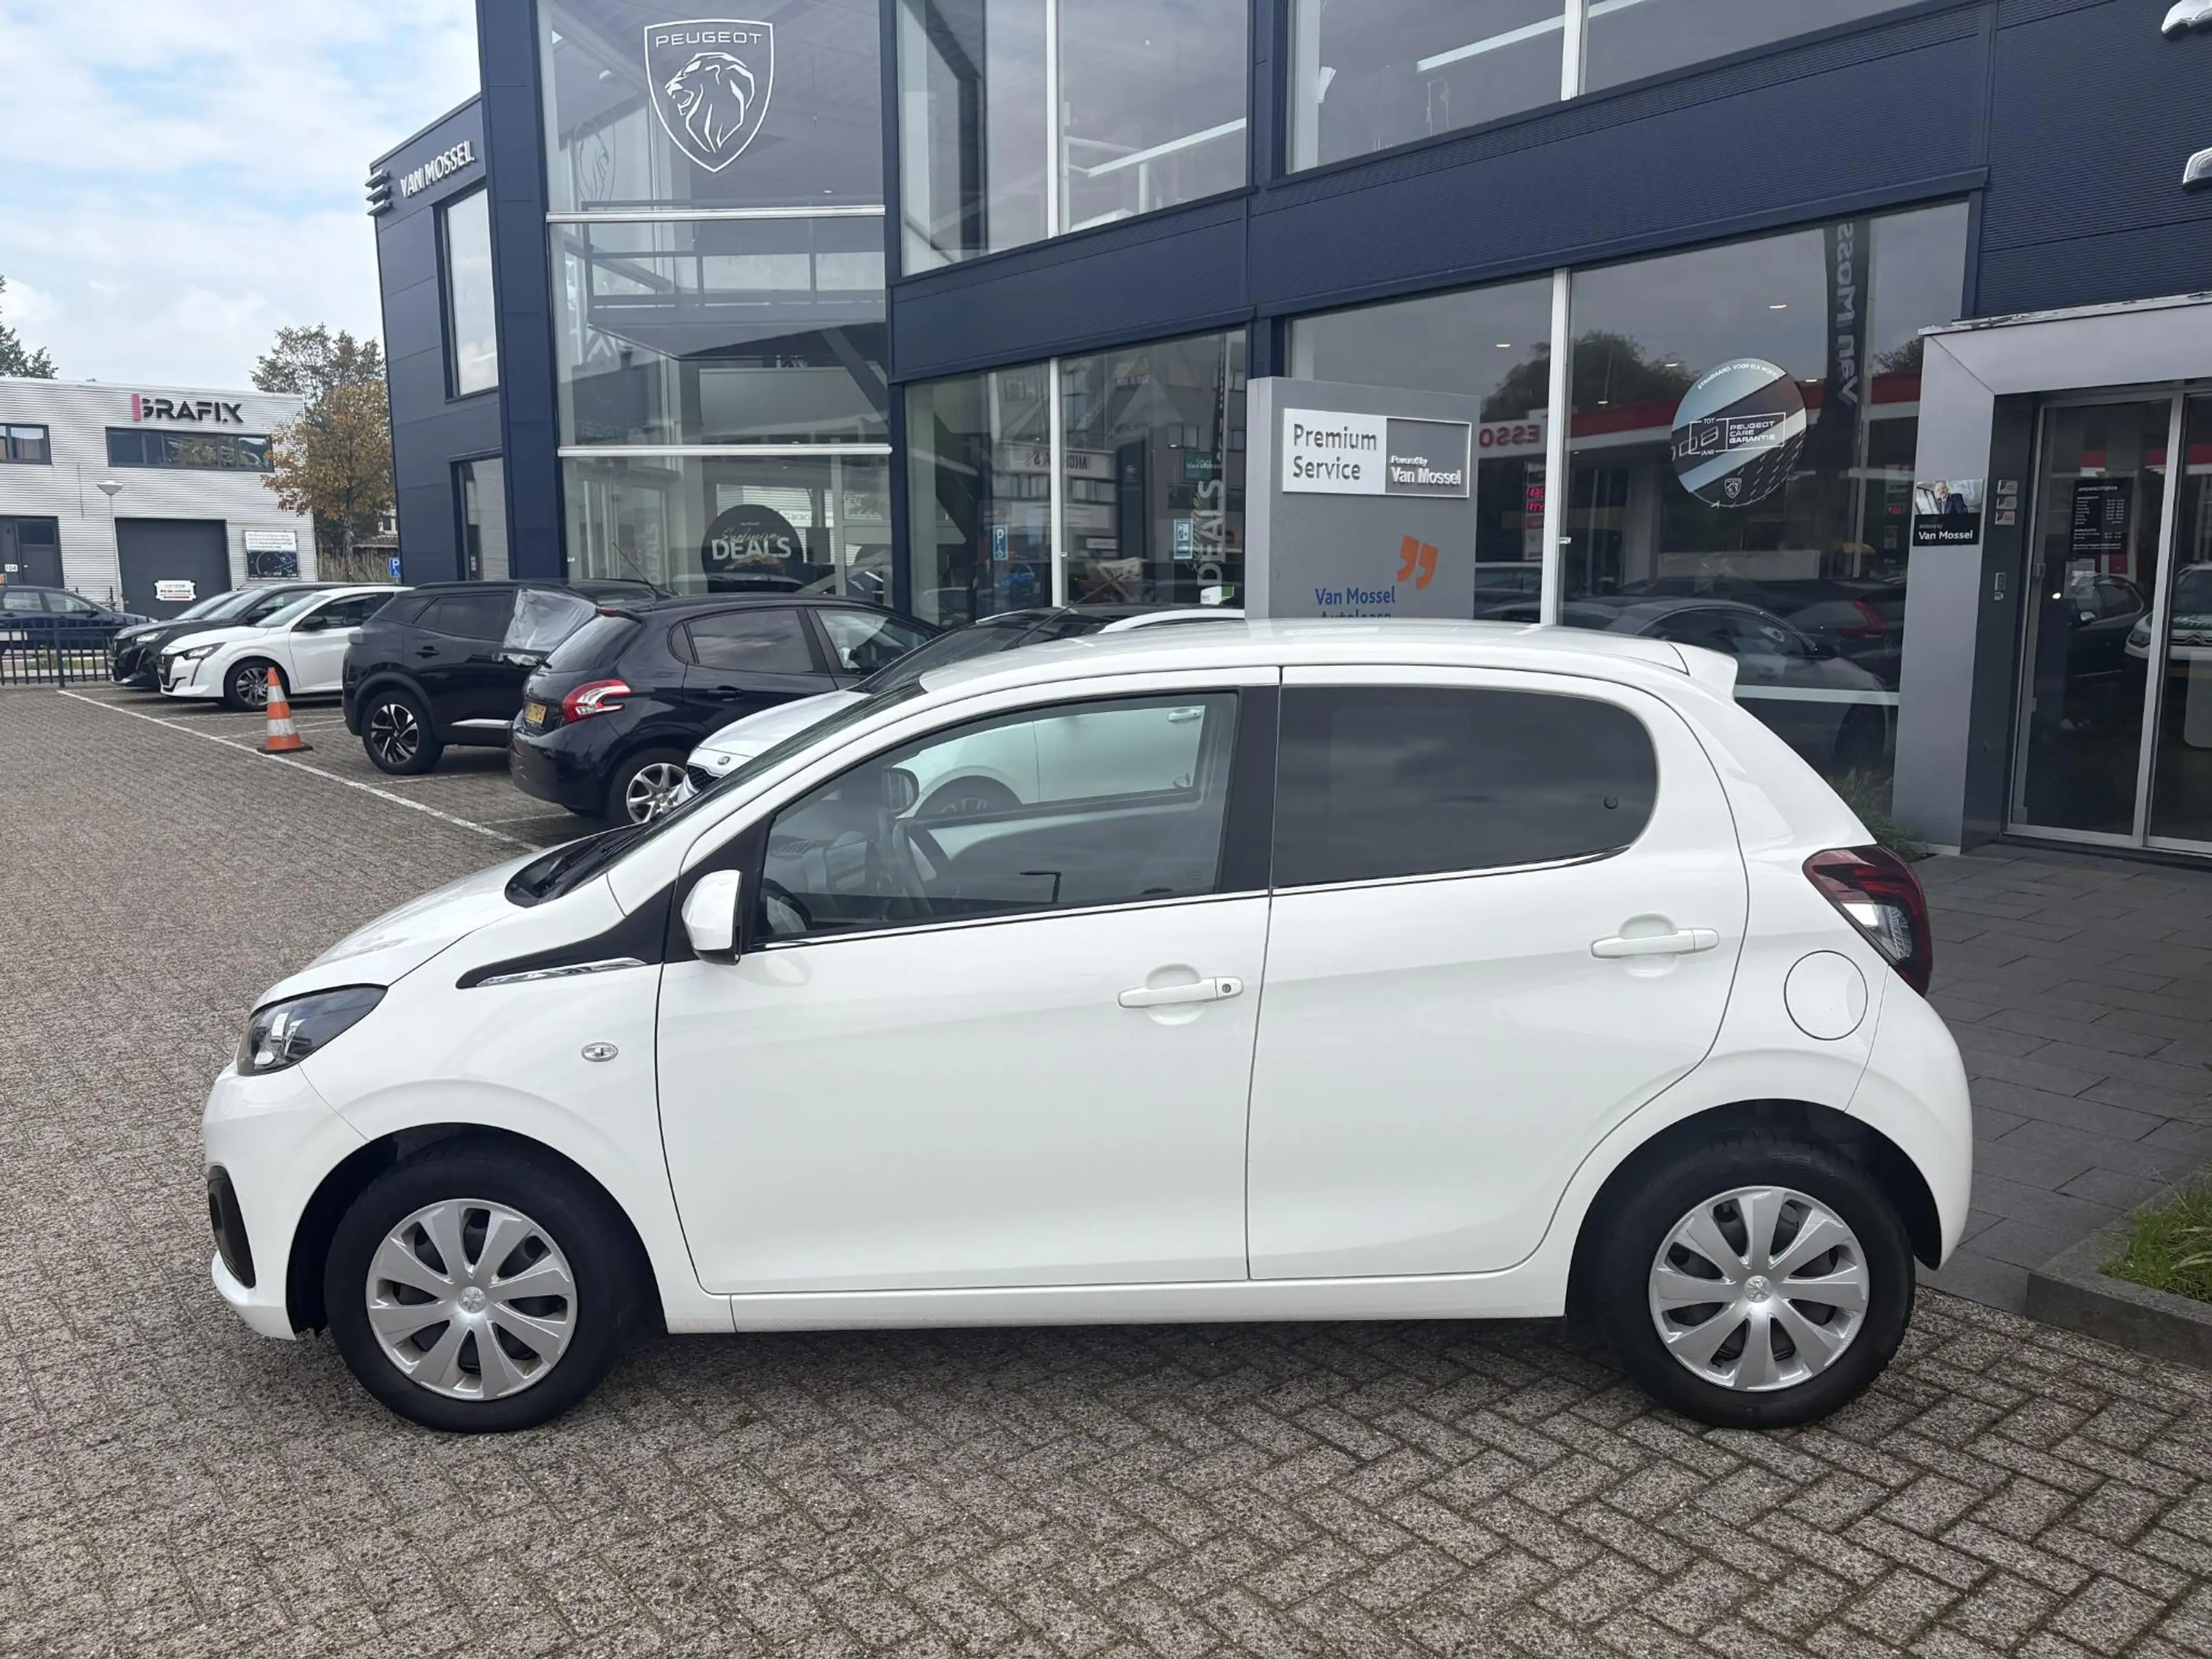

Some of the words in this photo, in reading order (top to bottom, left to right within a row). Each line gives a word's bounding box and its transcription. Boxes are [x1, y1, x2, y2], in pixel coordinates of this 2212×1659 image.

[656, 31, 762, 48] PEUGEOT
[399, 167, 425, 198] VAN
[425, 140, 475, 185] MOSSEL
[1293, 423, 1377, 450] Premium
[1730, 421, 1775, 430] PEUGEOT
[1293, 455, 1361, 480] Service
[1390, 466, 1415, 483] Van
[1417, 467, 1461, 484] Mossel
[1198, 479, 1224, 586] DEALS
[1918, 531, 1936, 540] Van
[1939, 529, 1973, 539] Mossel
[711, 536, 791, 560] DEALS
[1315, 588, 1343, 605] Van
[1346, 584, 1396, 605] Mossel
